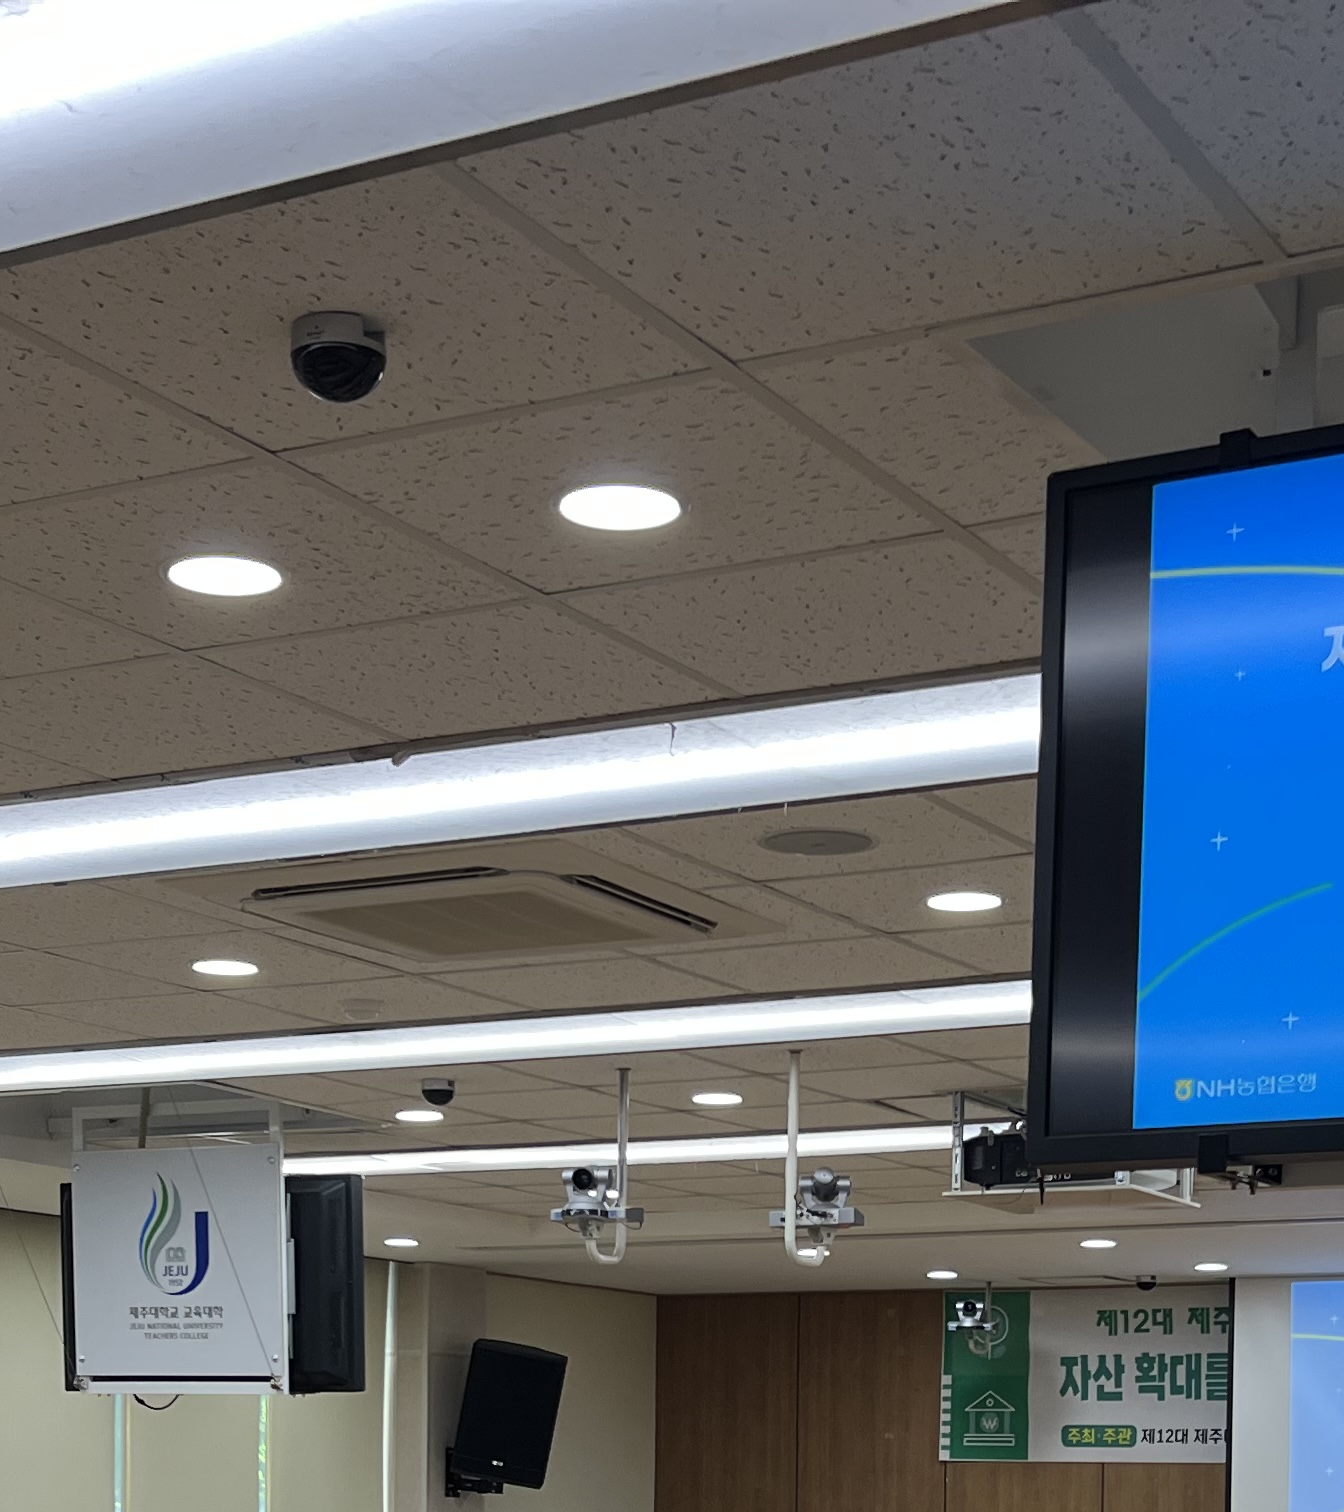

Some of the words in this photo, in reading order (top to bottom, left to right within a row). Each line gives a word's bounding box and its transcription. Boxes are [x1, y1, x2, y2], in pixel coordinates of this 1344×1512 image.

[1196, 1072, 1318, 1099] NH농협은행
[162, 1265, 189, 1277] JEJU
[129, 1306, 179, 1319] 제주대학교
[183, 1305, 224, 1319] 교육대학
[1096, 1308, 1173, 1336] 제12대
[1059, 1354, 1125, 1401] 자산
[1135, 1352, 1229, 1401] 확대를
[1141, 1428, 1189, 1445] 제12대
[1193, 1428, 1228, 1445] 제주
